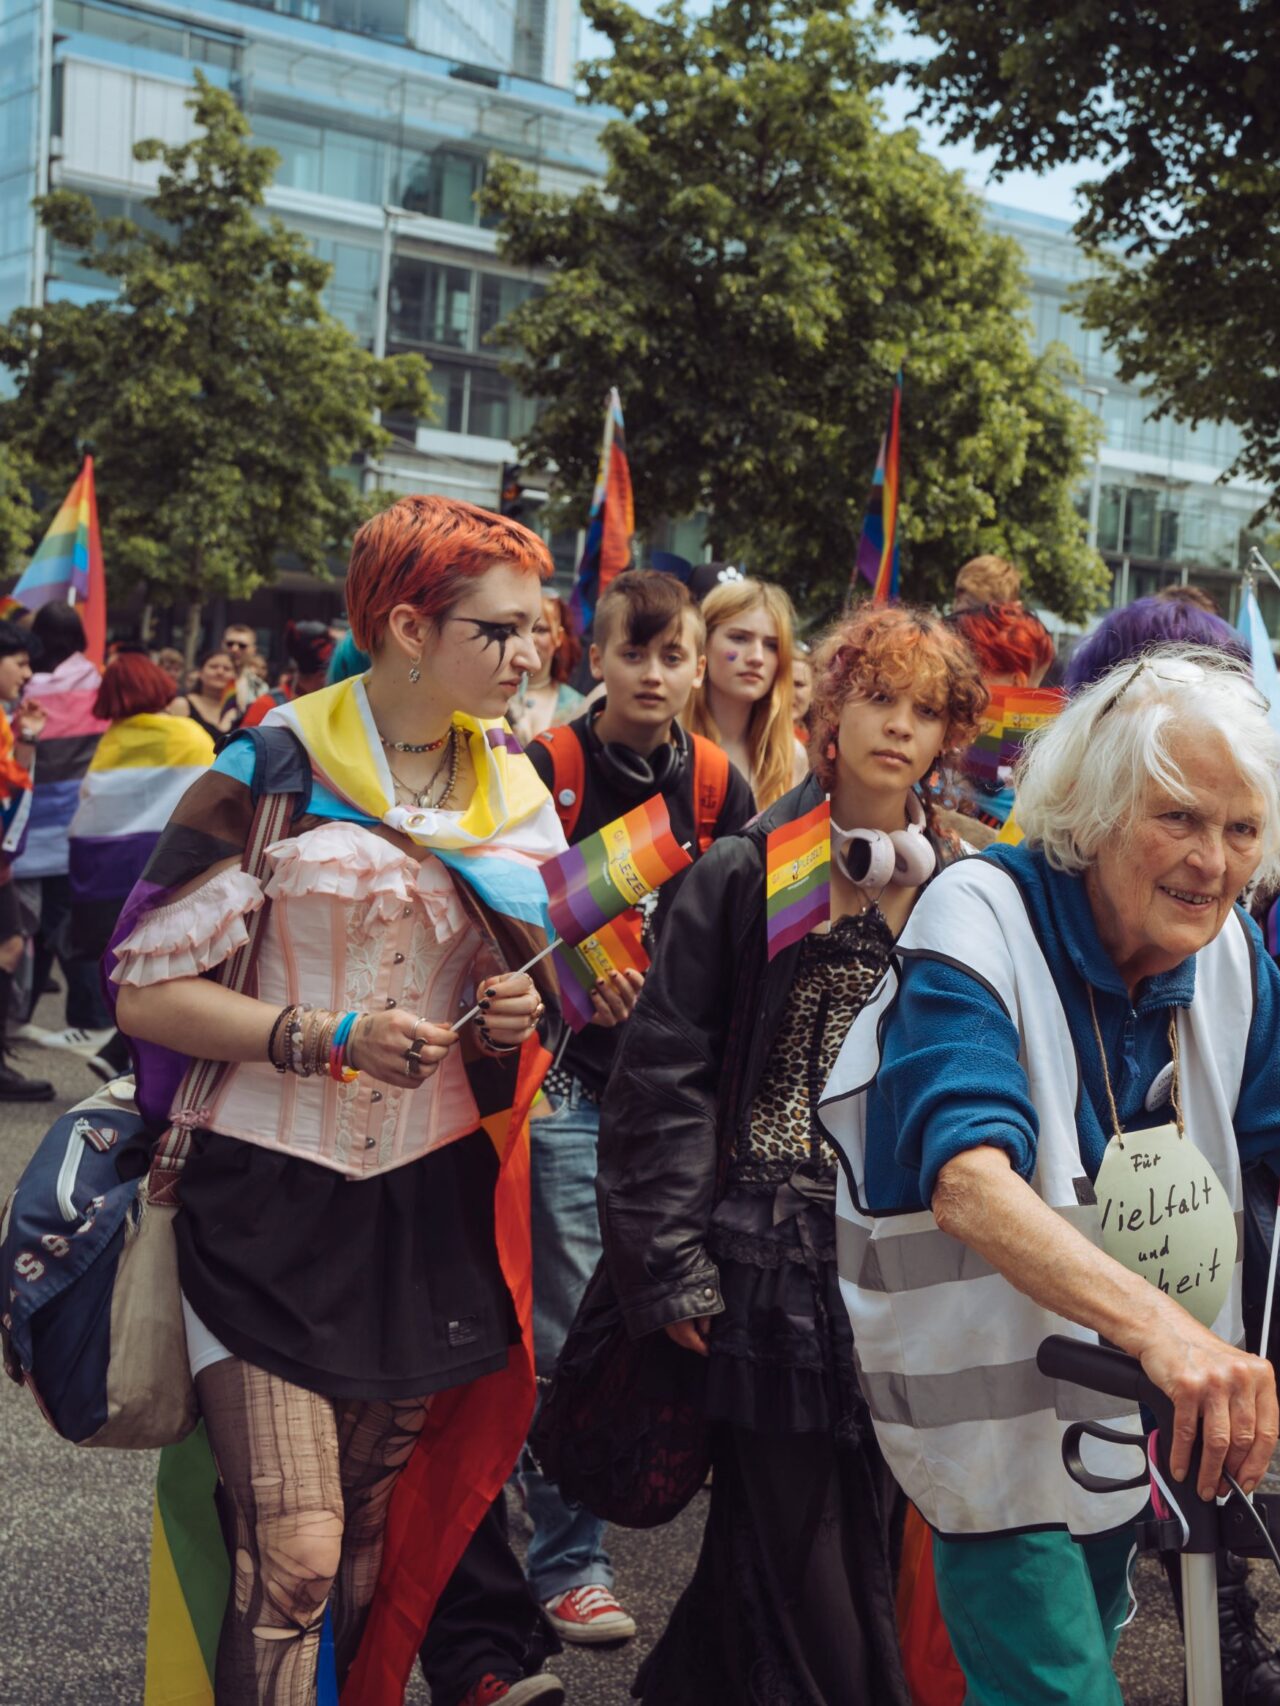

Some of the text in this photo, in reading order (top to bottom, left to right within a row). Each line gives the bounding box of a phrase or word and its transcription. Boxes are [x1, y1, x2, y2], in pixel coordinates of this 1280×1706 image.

[1130, 1153, 1161, 1172] Für
[1138, 1234, 1170, 1262] und
[1143, 1247, 1221, 1294] heit
